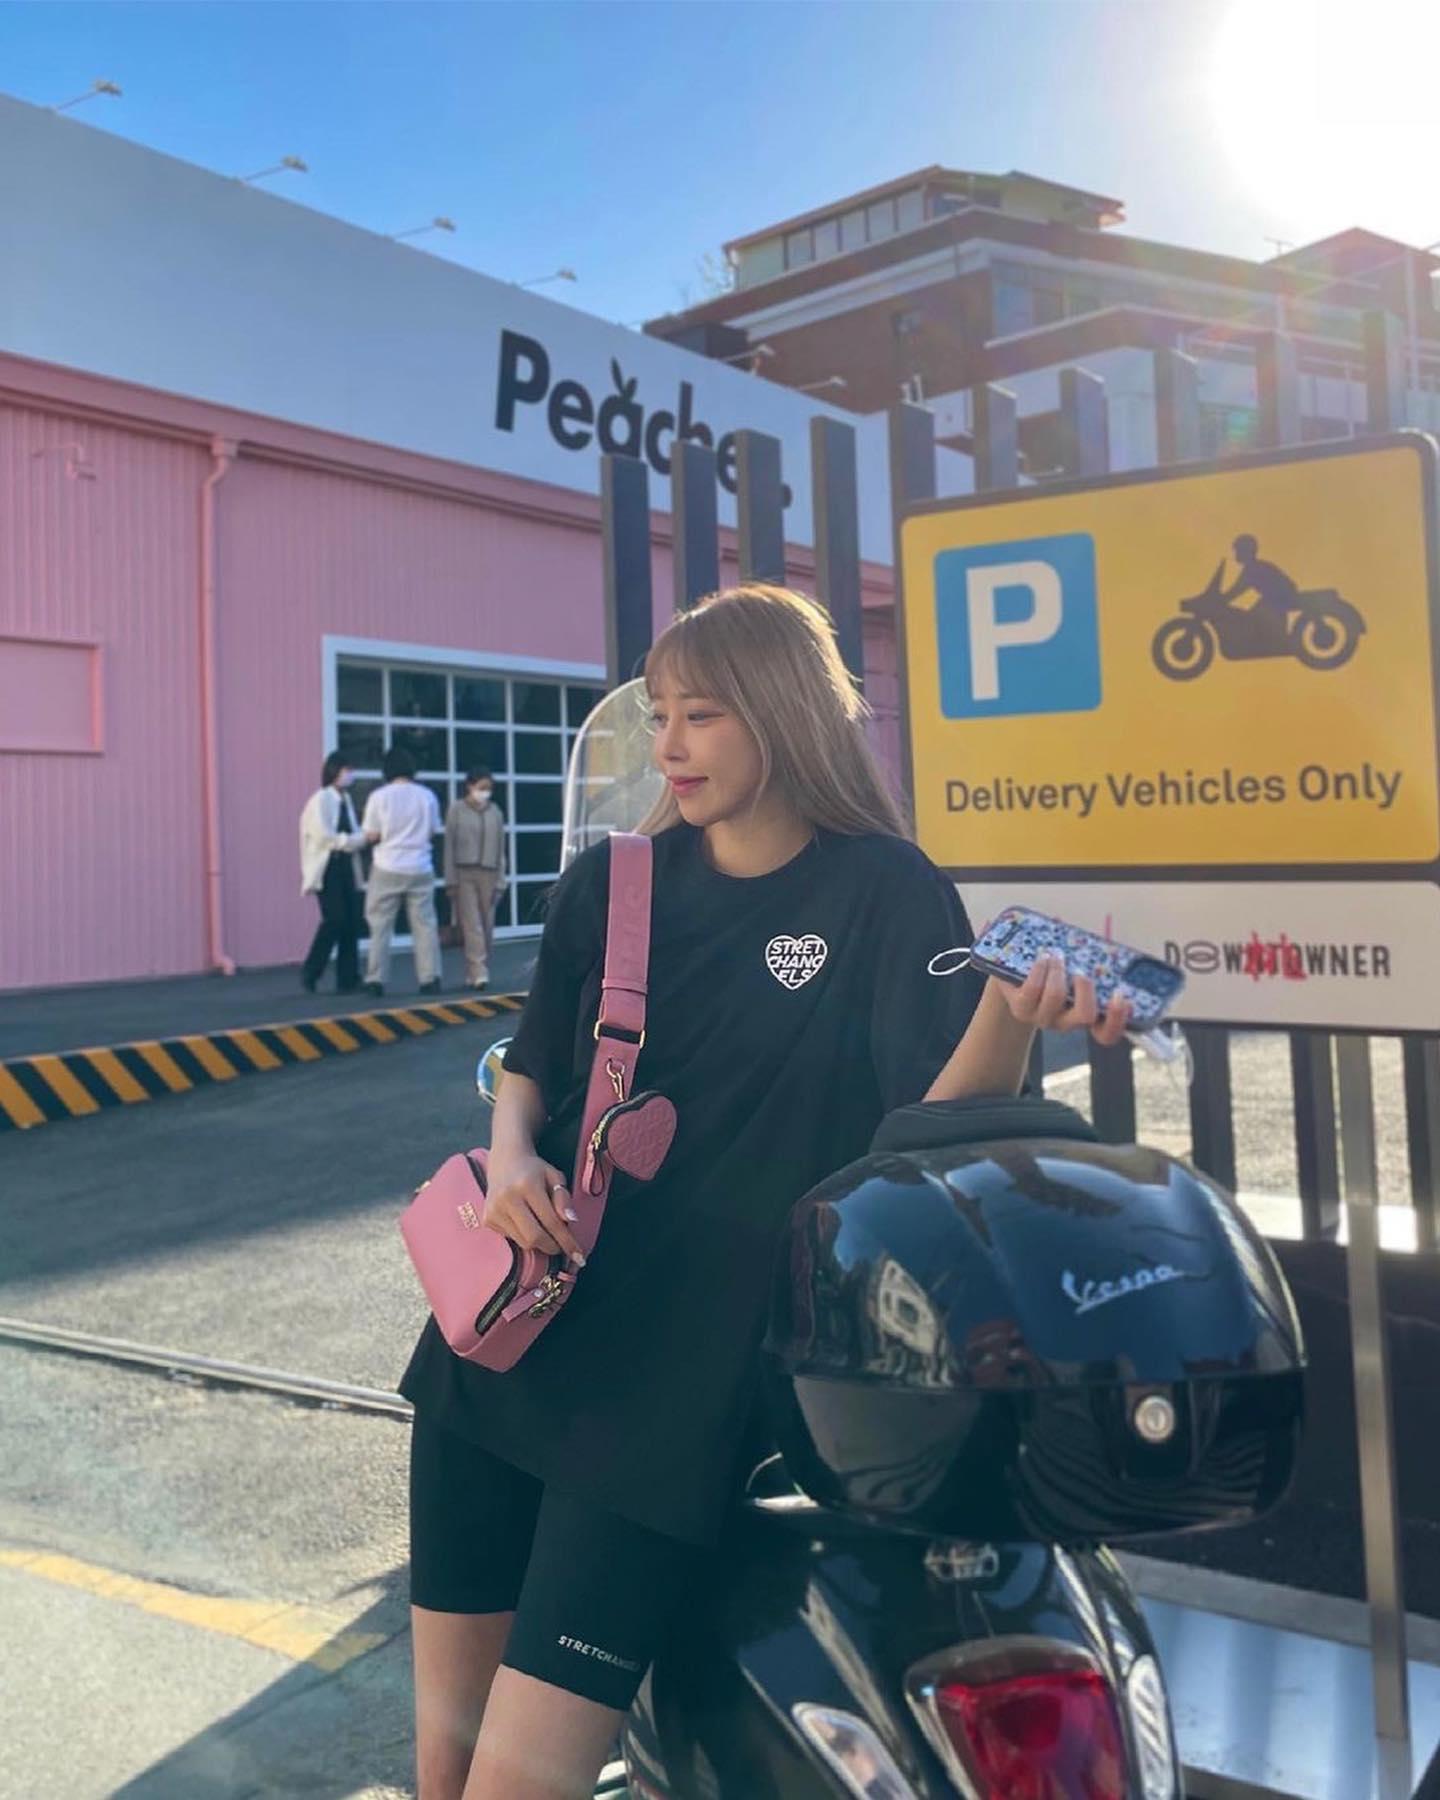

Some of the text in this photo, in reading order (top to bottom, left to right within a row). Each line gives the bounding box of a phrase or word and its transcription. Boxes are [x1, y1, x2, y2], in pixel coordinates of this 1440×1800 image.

[494, 328, 792, 509] Peache
[965, 560, 1063, 701] P
[945, 763, 1402, 818] Delivery Vehicles Only
[770, 940, 822, 955] STRET
[1061, 1264, 1186, 1315] Vespa
